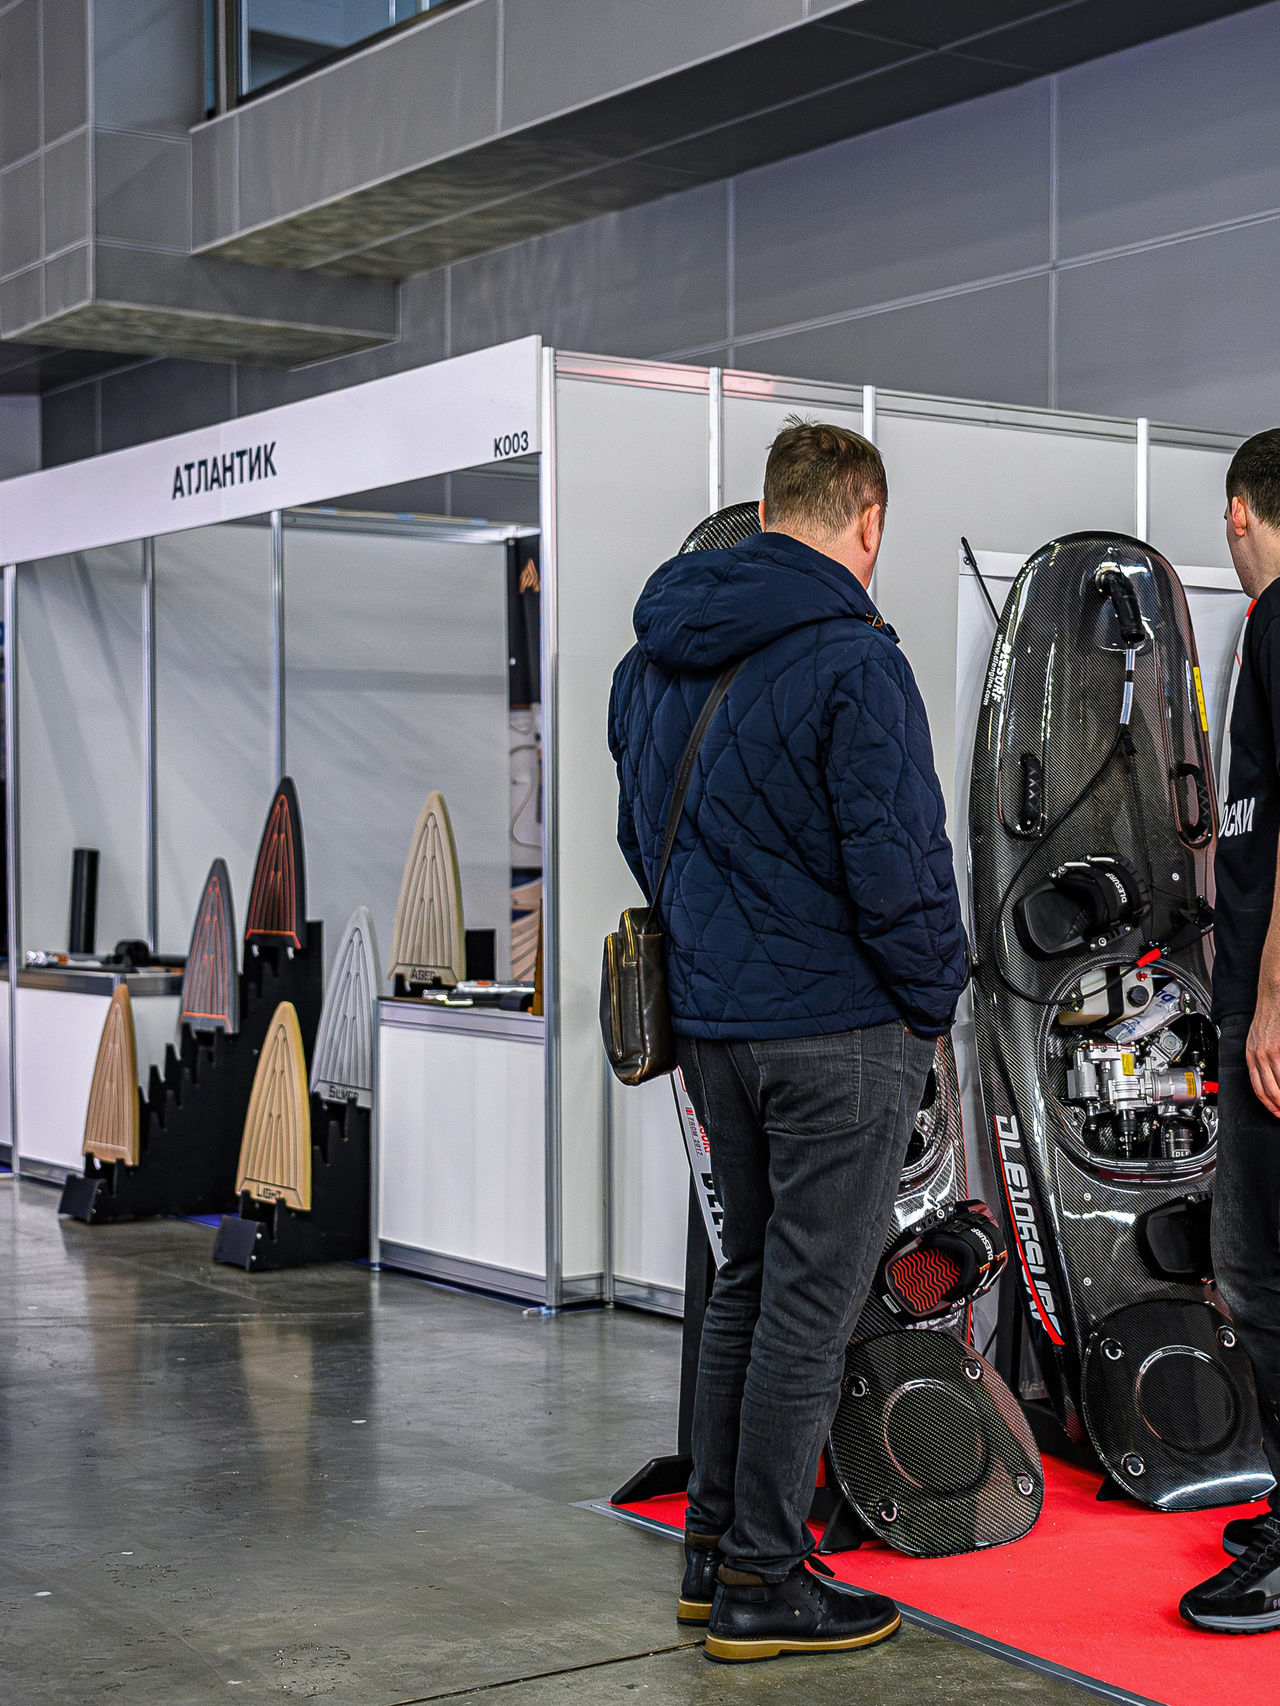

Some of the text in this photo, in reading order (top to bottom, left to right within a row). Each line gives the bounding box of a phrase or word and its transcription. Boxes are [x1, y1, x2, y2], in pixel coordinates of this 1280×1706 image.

[172, 442, 278, 500] АТЛАНТИК
[991, 642, 1012, 703] DLESURF
[1104, 872, 1128, 904] DLESURF
[970, 1226, 995, 1261] DLESURF
